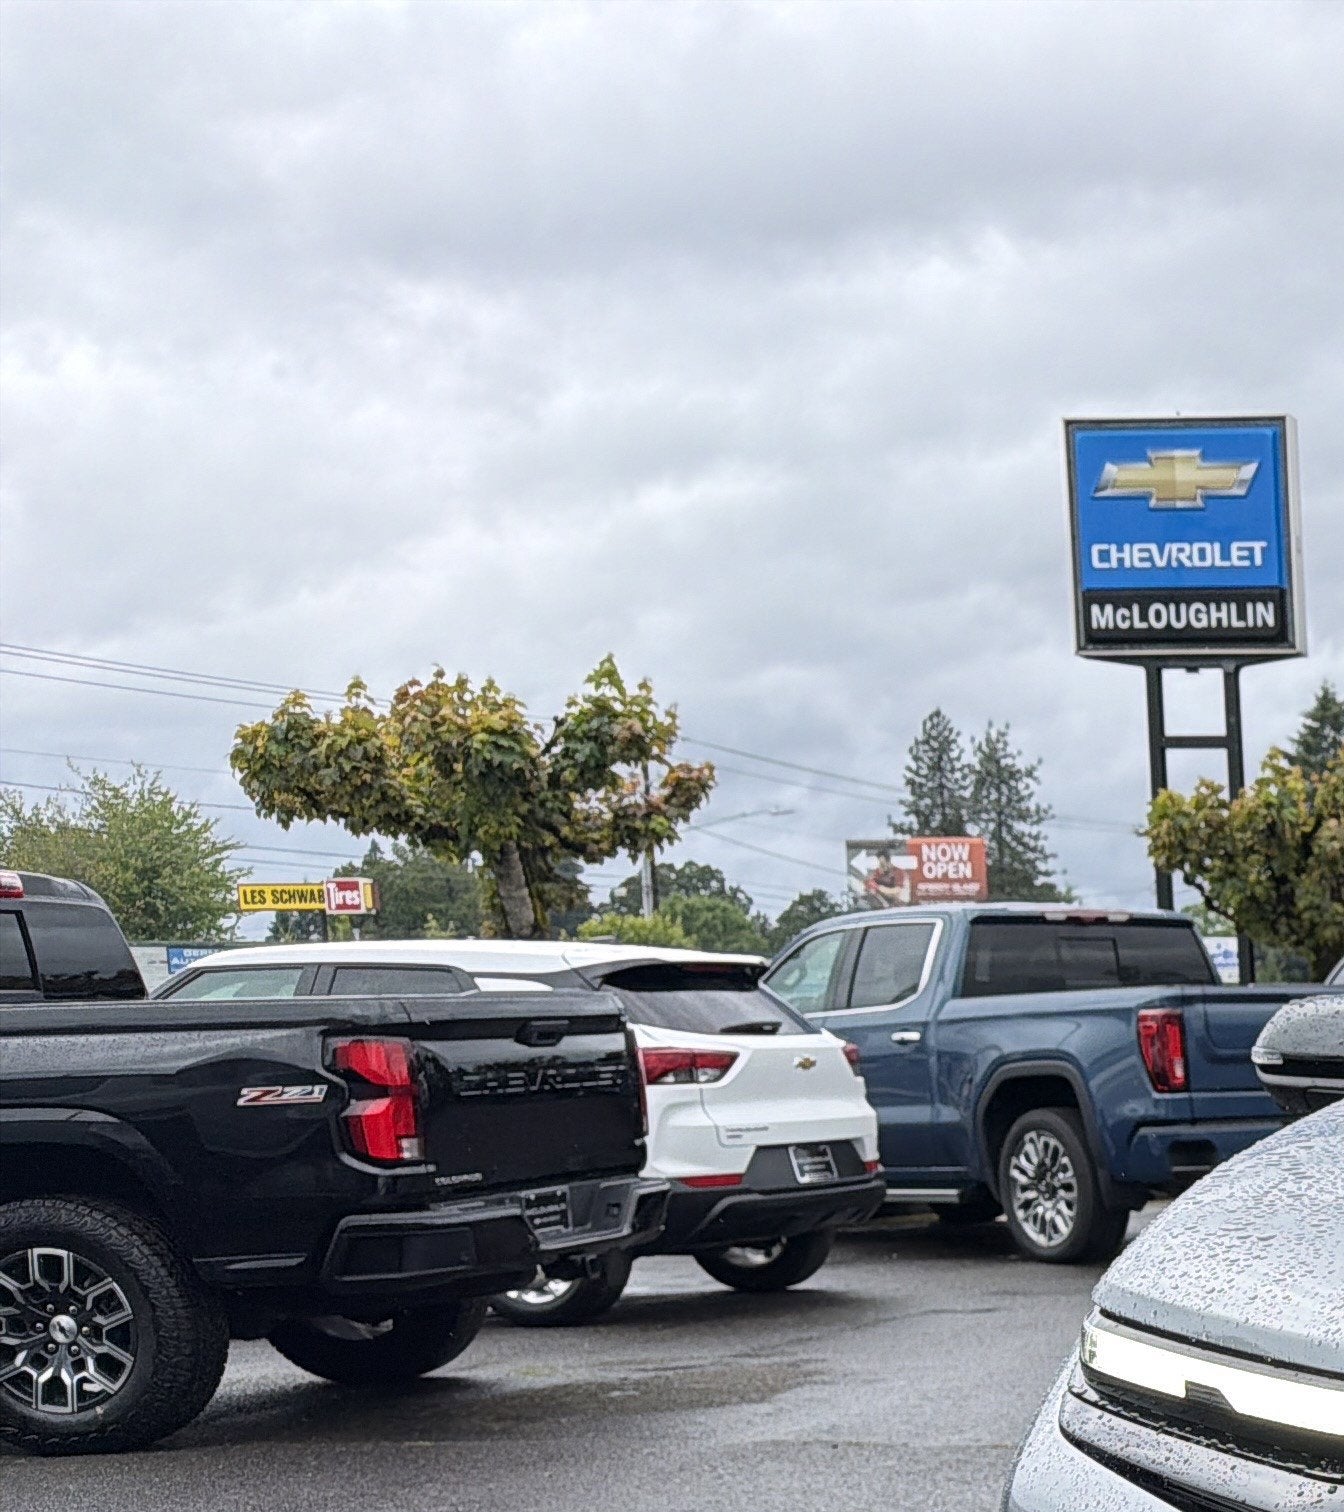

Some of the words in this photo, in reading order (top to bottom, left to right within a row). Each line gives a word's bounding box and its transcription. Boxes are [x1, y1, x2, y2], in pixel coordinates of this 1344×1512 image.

[1091, 541, 1268, 568] CHEVROLET
[1090, 602, 1275, 629] McLOUGHLIN
[921, 843, 970, 862] NOW
[922, 861, 973, 879] OPEN
[242, 889, 267, 905] LES
[270, 888, 325, 905] SCHWAB
[327, 881, 360, 910] Tires
